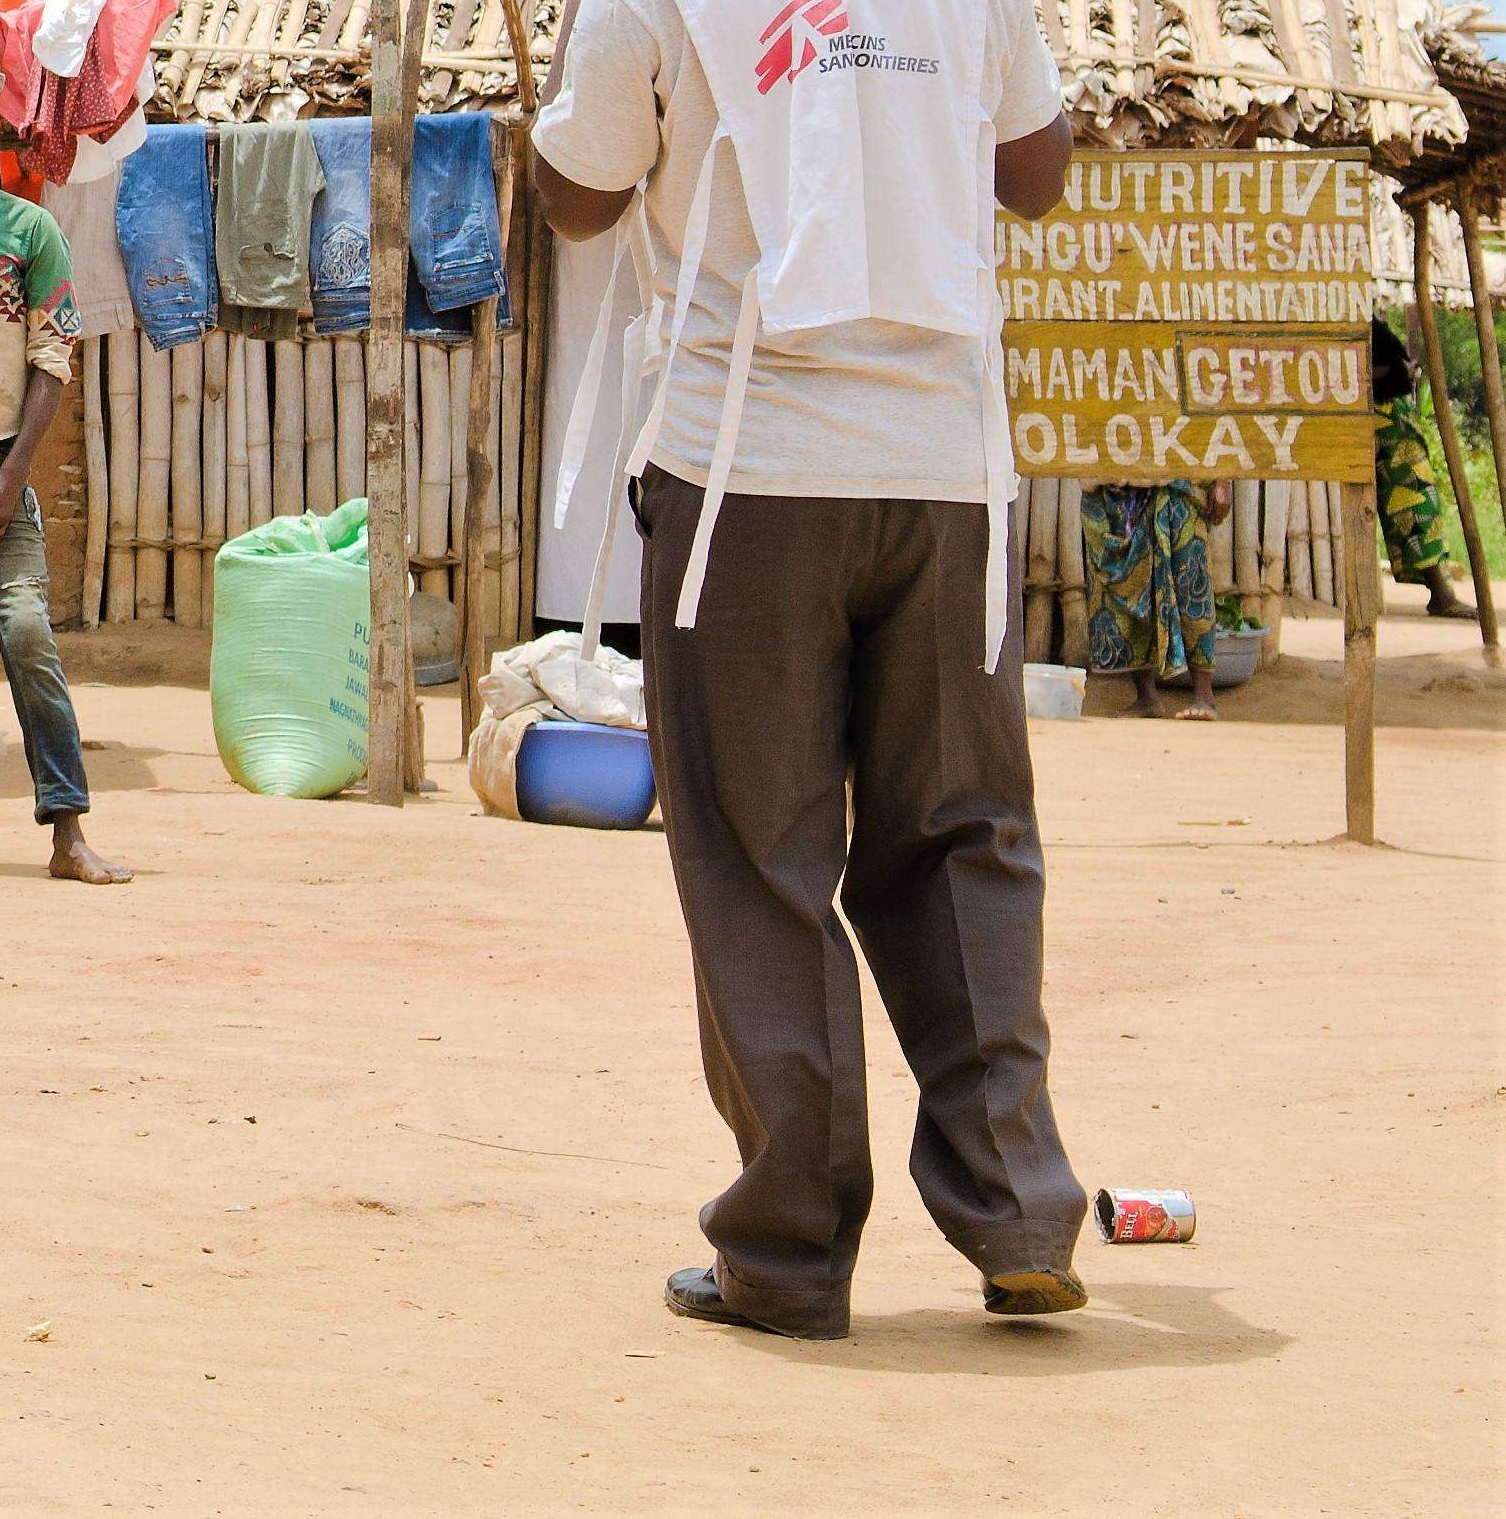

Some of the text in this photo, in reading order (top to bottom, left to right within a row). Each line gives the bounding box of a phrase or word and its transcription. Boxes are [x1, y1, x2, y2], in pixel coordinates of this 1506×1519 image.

[1266, 222, 1373, 273] SANA
[1008, 346, 1361, 406] MAMAN GETOU
[1014, 412, 1305, 472] OLOKAY
